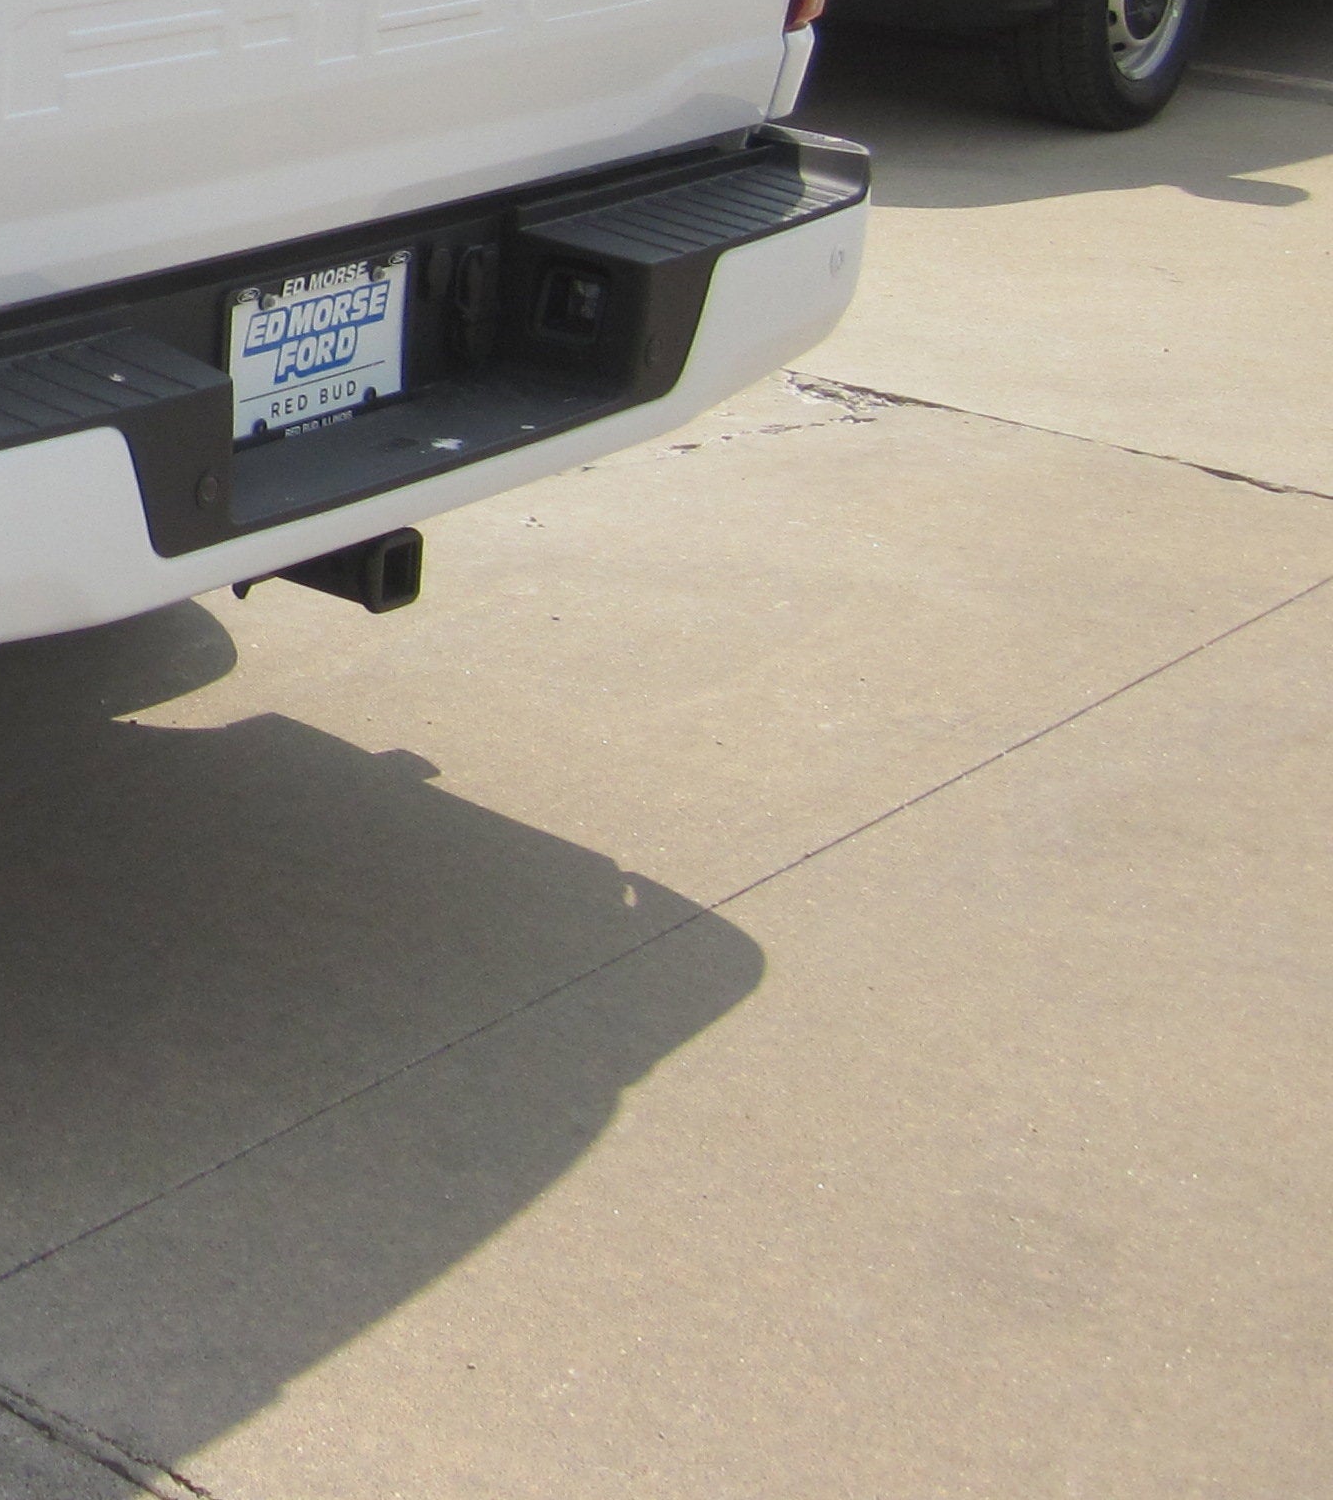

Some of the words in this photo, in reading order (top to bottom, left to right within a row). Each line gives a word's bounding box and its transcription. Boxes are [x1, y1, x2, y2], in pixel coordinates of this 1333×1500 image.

[283, 278, 306, 298] ED
[308, 261, 369, 292] MORSE
[244, 308, 288, 351] ED
[286, 280, 390, 342] MORSE
[274, 326, 358, 383] FORD
[271, 394, 308, 418] RED
[320, 380, 357, 404] BUD
